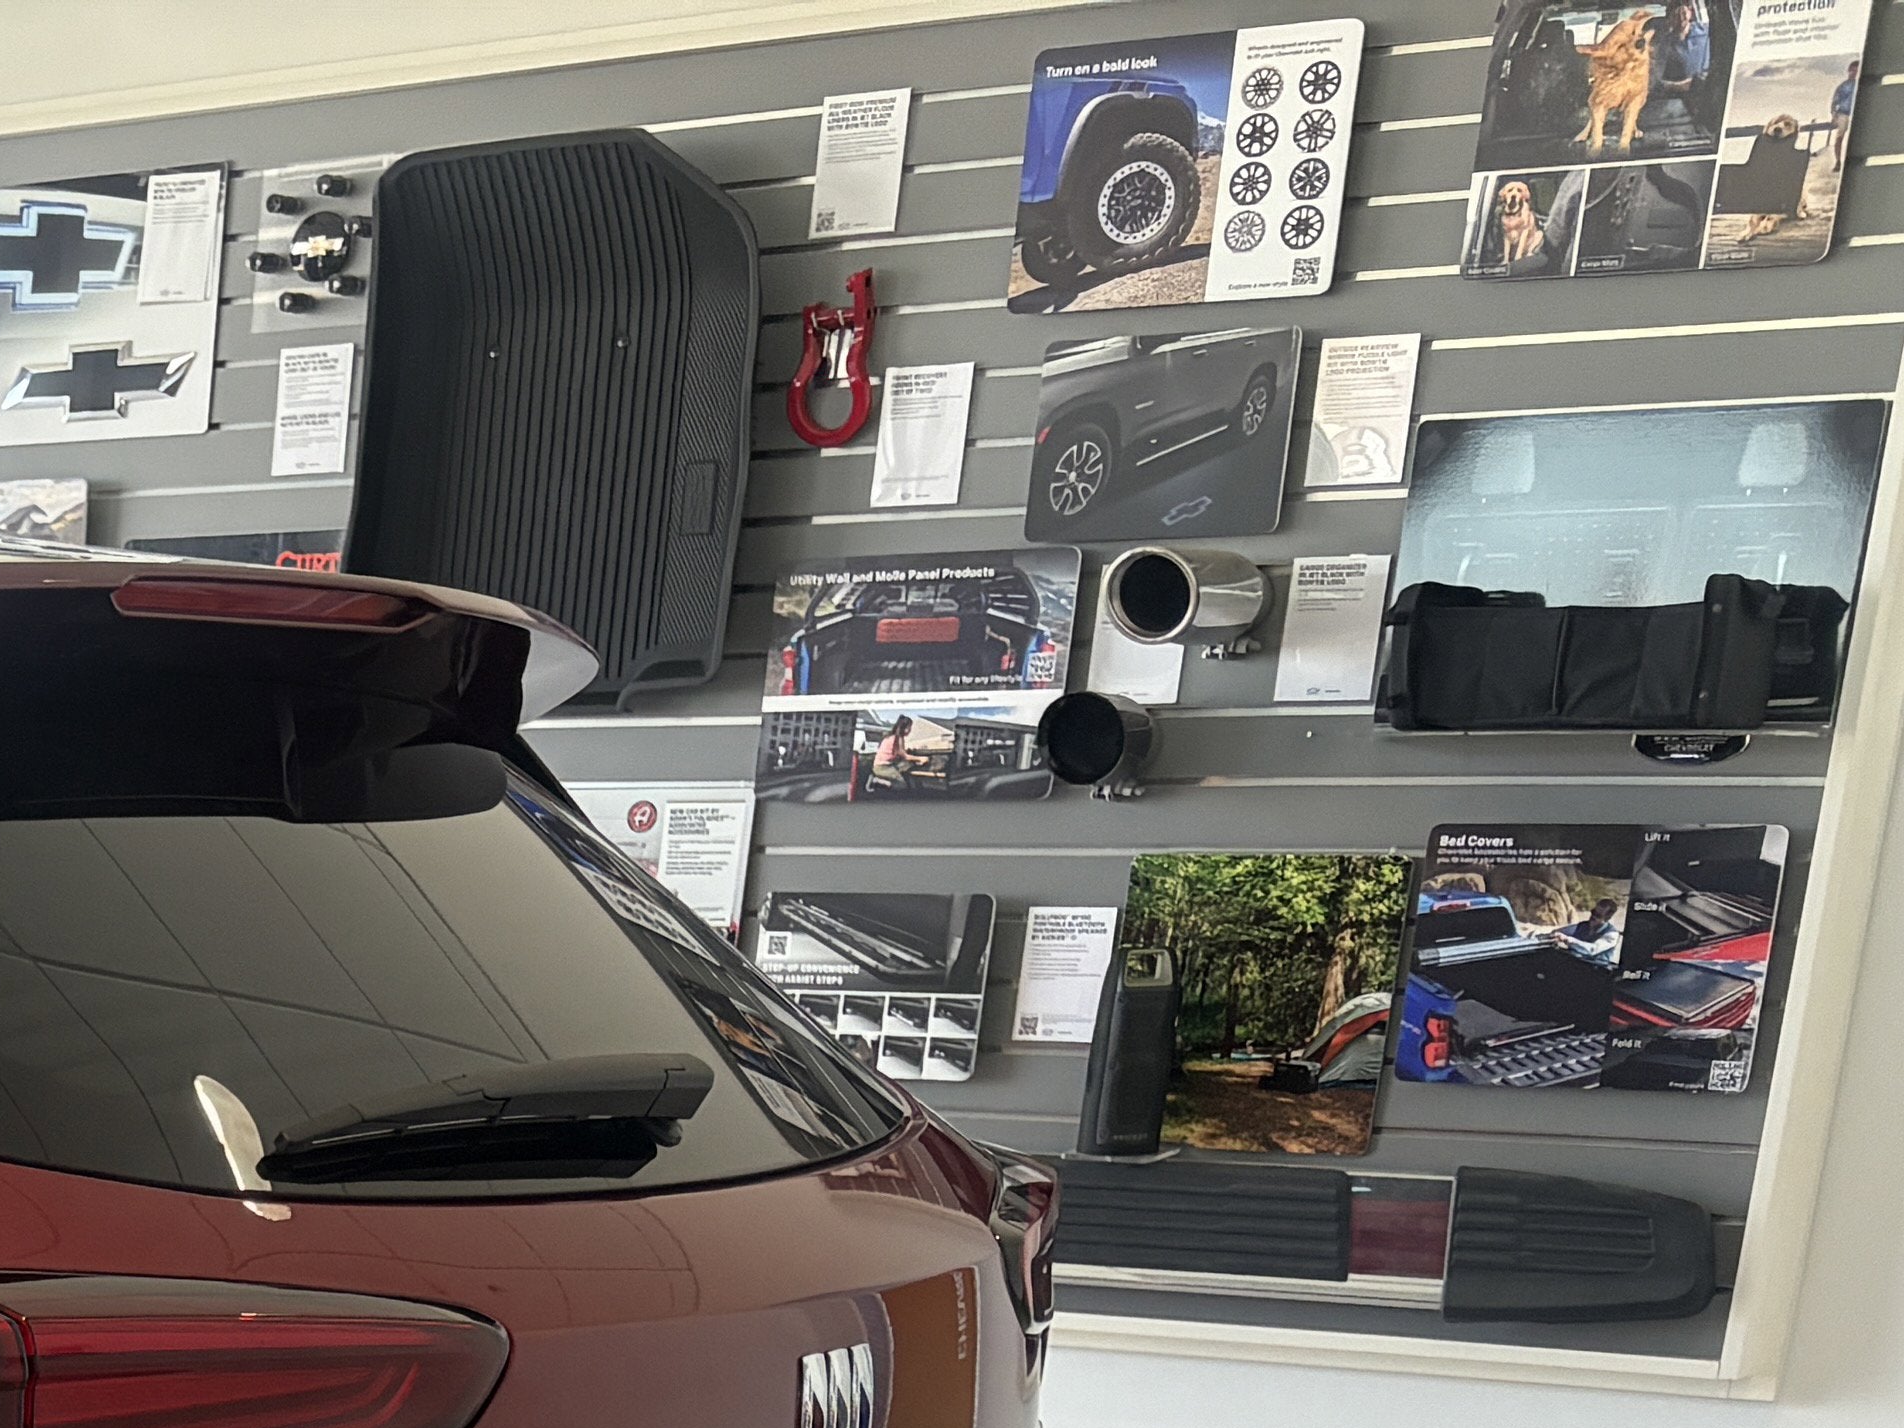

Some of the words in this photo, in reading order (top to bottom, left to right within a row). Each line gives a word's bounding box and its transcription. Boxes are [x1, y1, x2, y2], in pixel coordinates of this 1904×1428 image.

[1045, 65, 1073, 79] Turn
[1074, 64, 1091, 76] on
[1091, 64, 1101, 74] a
[1102, 57, 1129, 74] bold
[1131, 56, 1158, 70] look
[790, 574, 824, 587] Utility
[826, 573, 850, 585] Wall
[852, 571, 874, 583] and
[908, 568, 940, 581] Panel
[942, 566, 995, 578] Products
[949, 676, 961, 685] Fit
[962, 675, 973, 684] for
[1439, 834, 1466, 847] Bed
[1467, 836, 1514, 847] Covers
[1645, 833, 1661, 842] Lift
